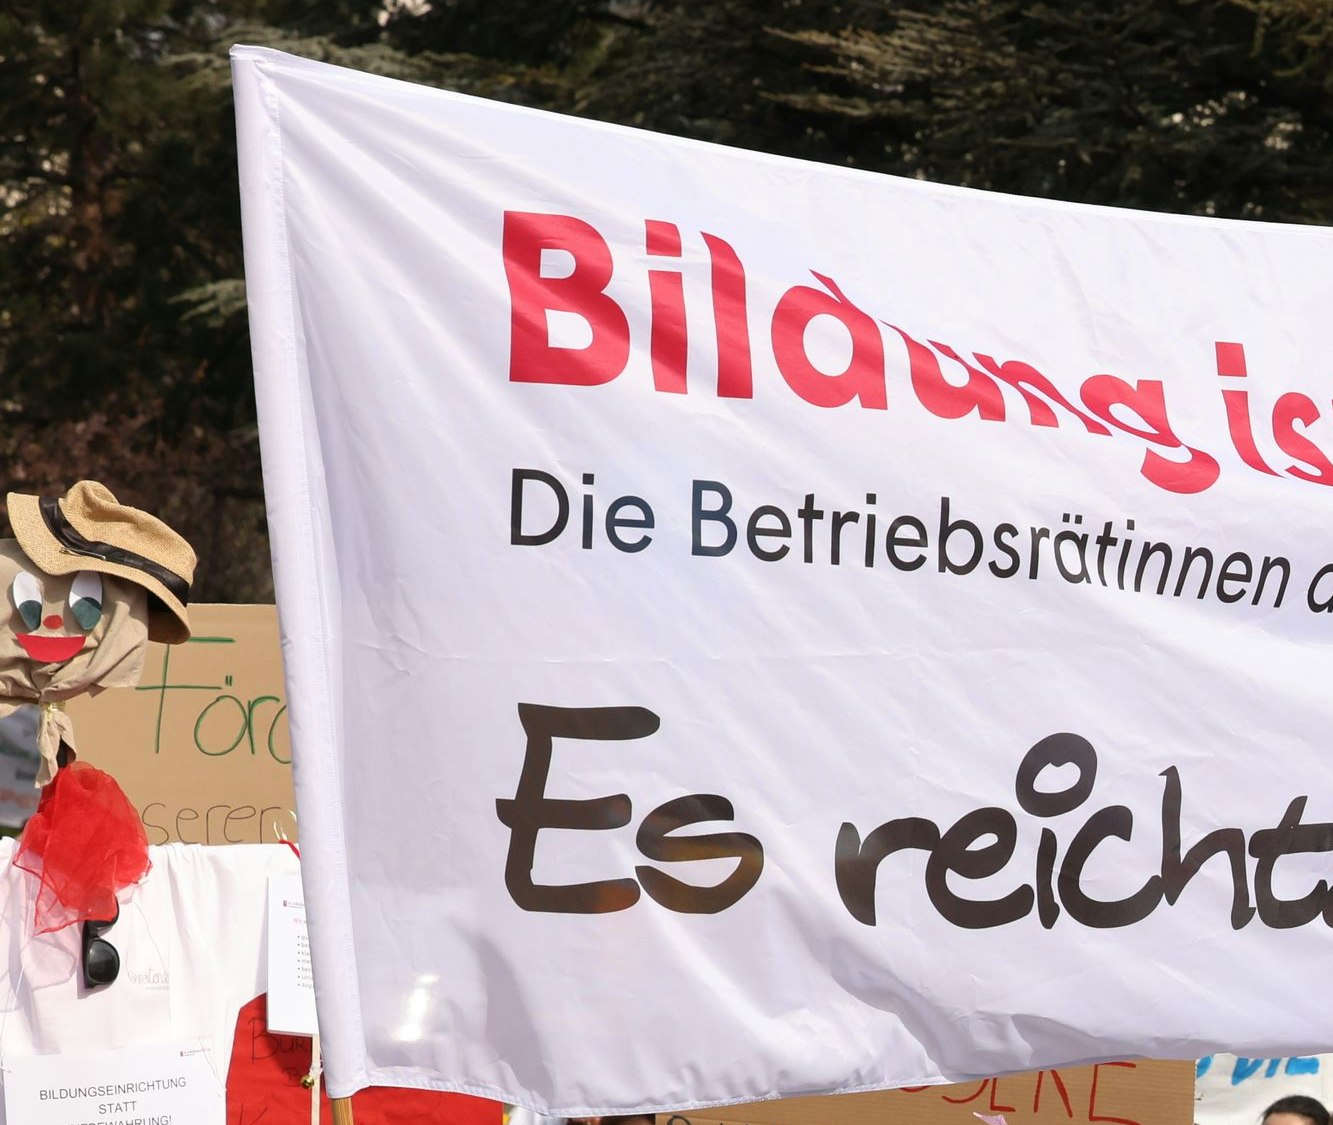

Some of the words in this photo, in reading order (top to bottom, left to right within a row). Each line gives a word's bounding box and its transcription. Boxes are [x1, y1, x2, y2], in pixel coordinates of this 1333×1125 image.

[503, 210, 1221, 494] Bildung
[510, 468, 655, 554] Die
[691, 479, 1294, 610] Betriebsrätinnen
[495, 702, 764, 914] Es
[39, 1077, 187, 1102] BILDUNGSEINRICHTUNG
[98, 1101, 138, 1115] STATT
